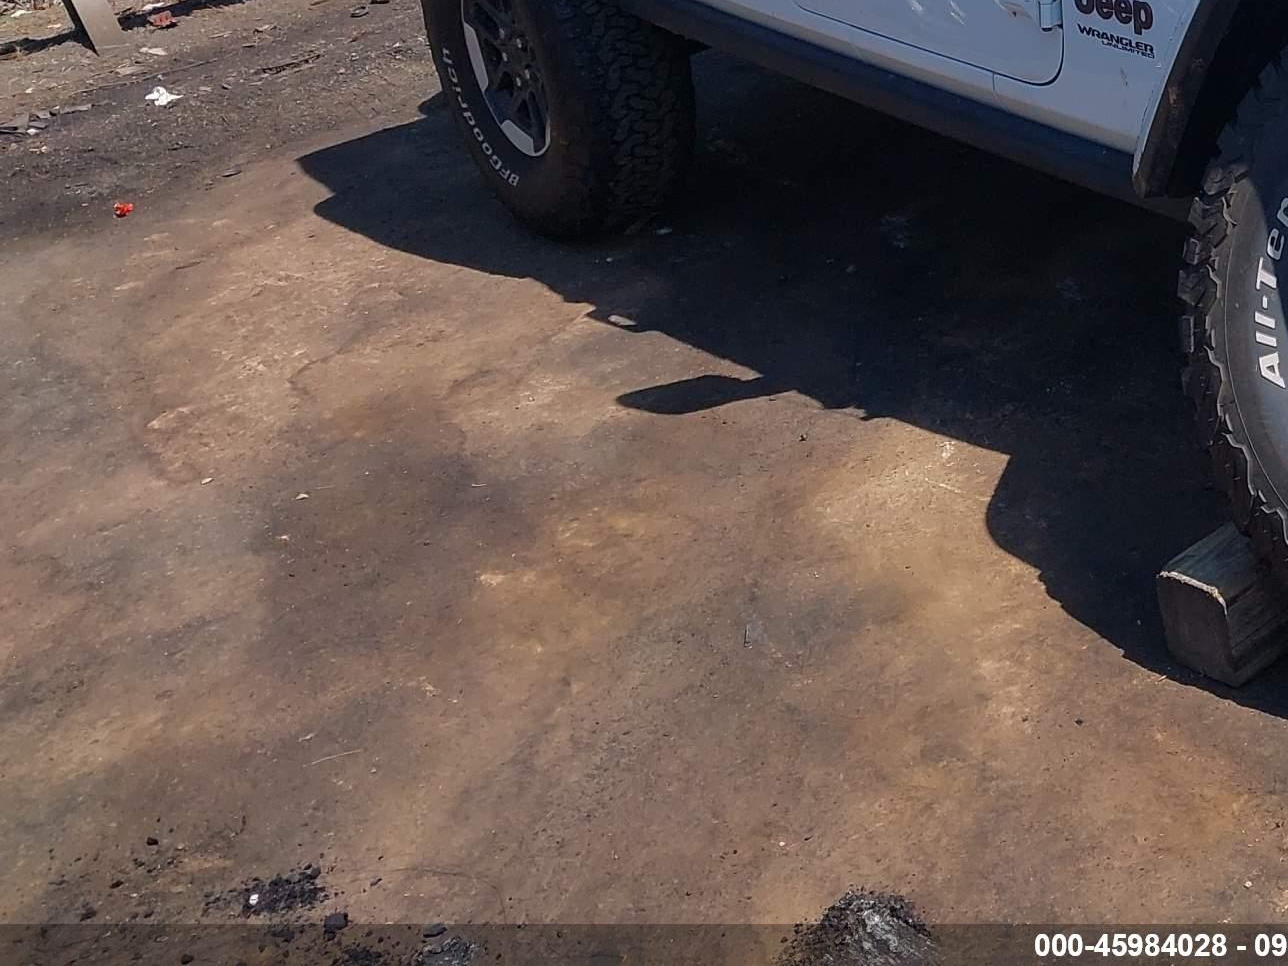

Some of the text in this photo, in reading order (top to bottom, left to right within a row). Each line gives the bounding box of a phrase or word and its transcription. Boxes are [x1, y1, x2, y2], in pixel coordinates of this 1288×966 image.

[1077, 23, 1155, 54] WRANGLER
[1101, 40, 1156, 60] UNLIMITED
[441, 46, 521, 187] BFGoodrich
